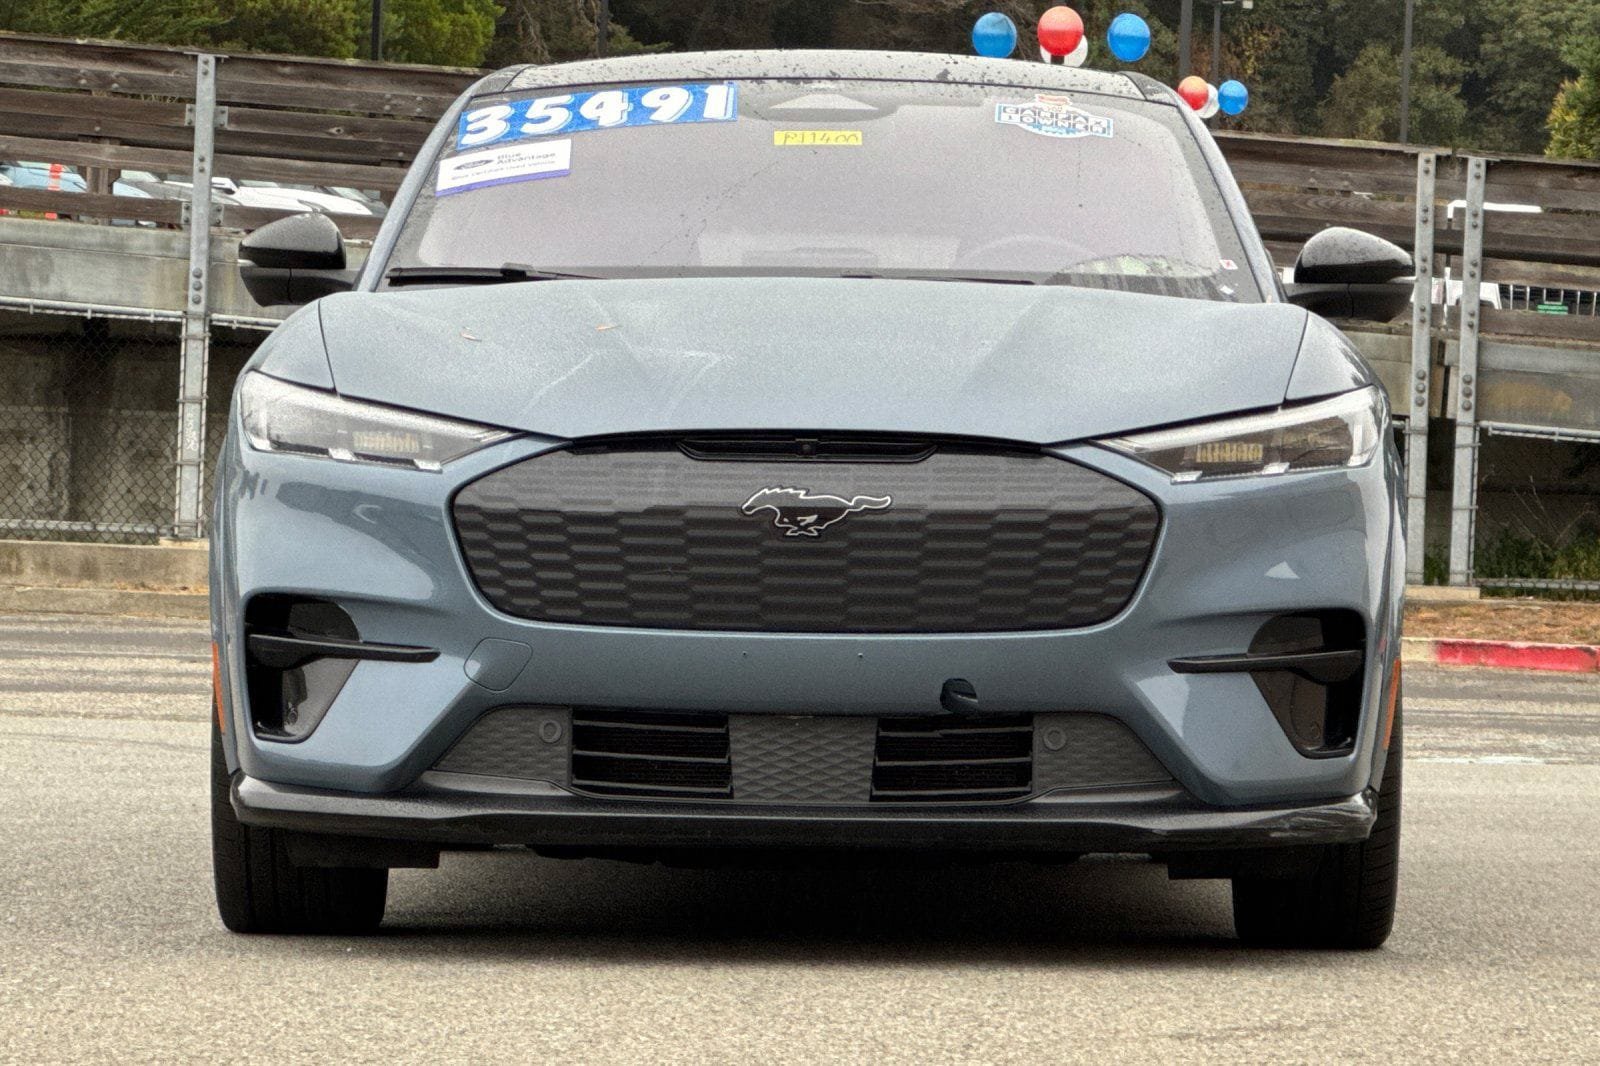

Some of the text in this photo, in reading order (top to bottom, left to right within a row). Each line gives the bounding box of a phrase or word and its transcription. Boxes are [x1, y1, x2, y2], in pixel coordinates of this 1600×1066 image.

[461, 84, 733, 145] 35491
[1003, 106, 1107, 127] CARFAX
[496, 152, 557, 165] Advantage
